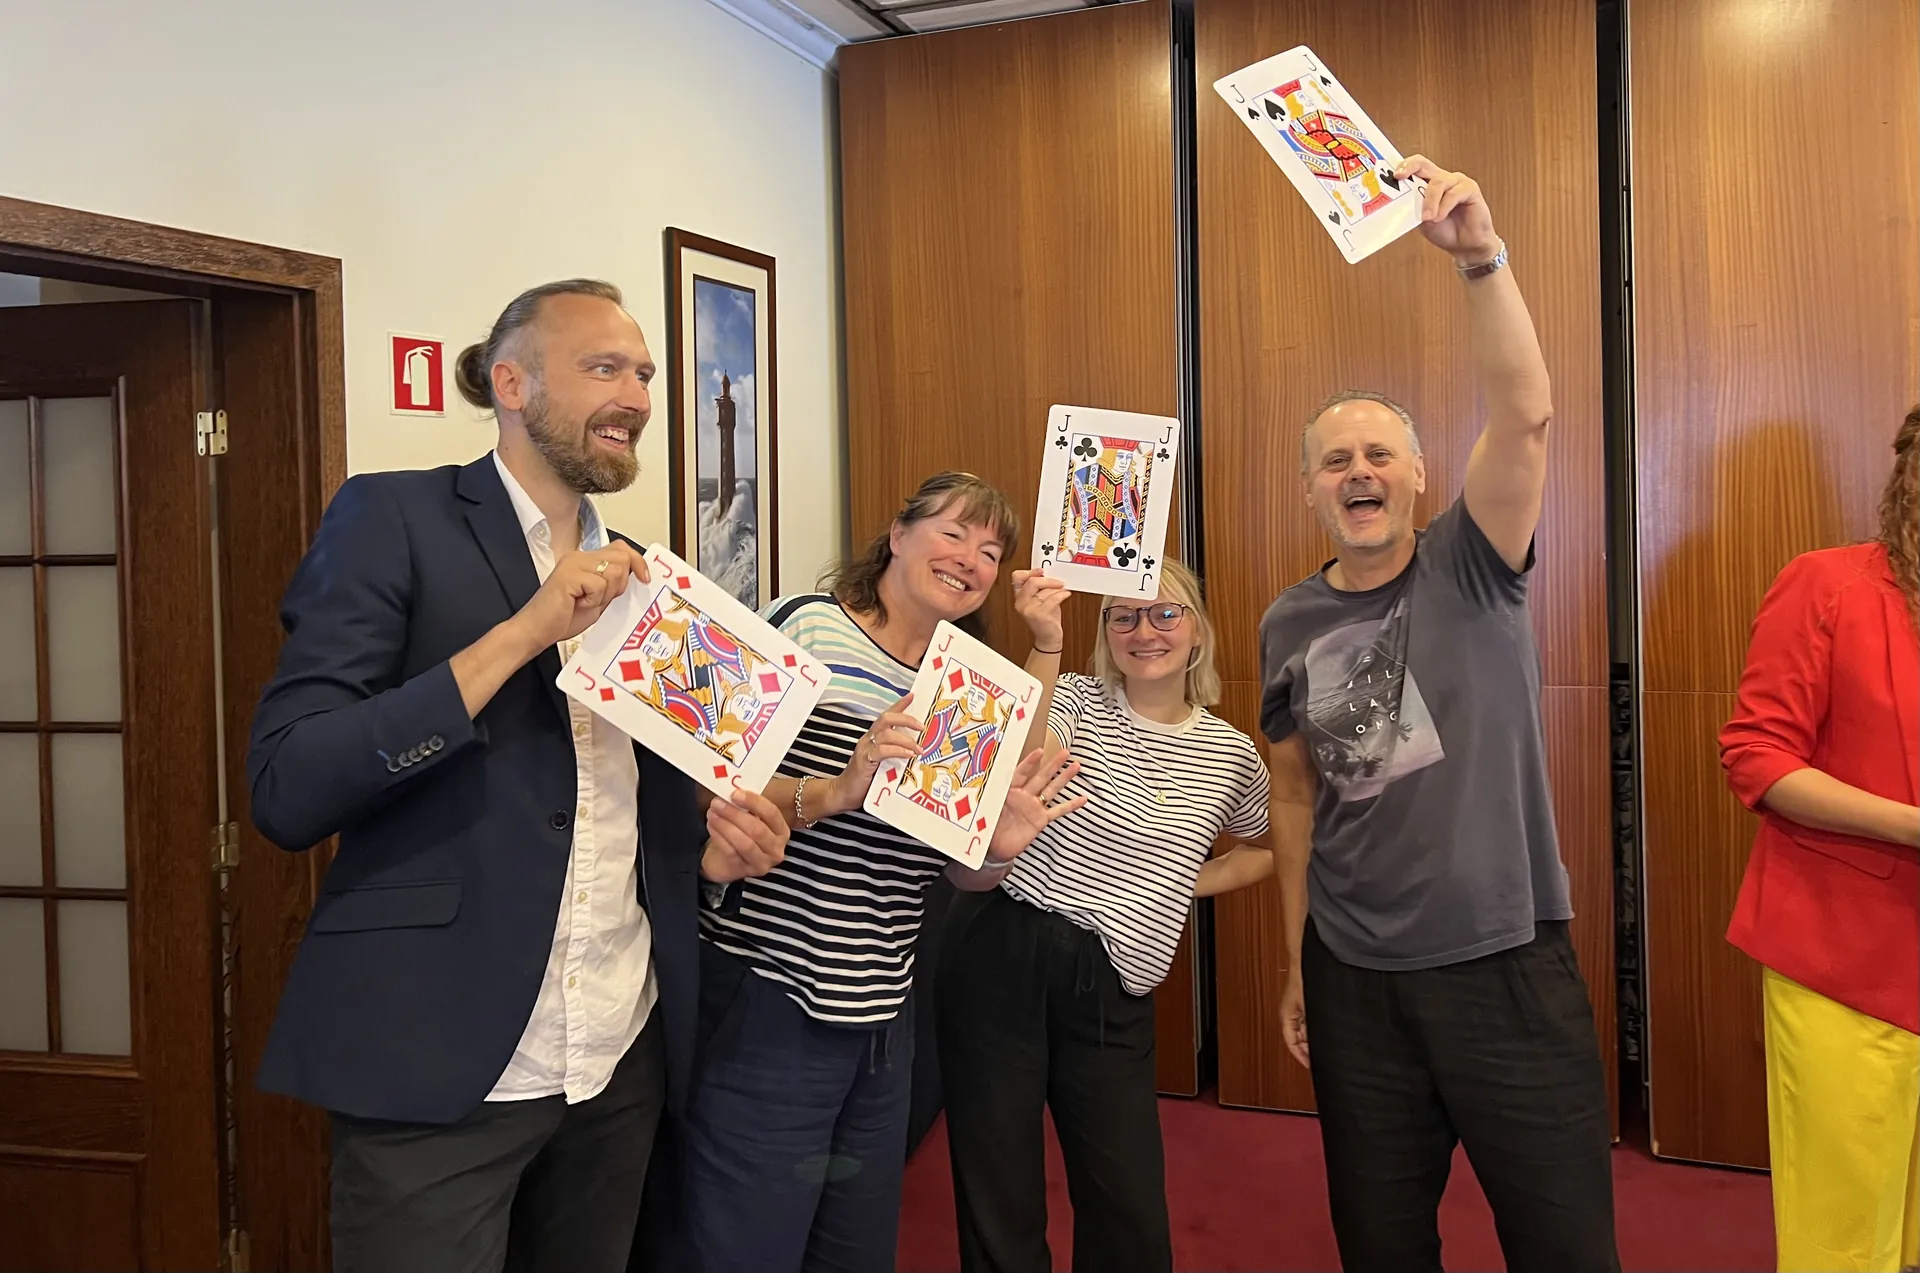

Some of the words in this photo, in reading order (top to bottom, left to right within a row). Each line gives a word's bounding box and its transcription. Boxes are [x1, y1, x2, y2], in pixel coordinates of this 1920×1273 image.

[1302, 54, 1317, 72] J
[1230, 84, 1245, 104] J
[1342, 229, 1356, 252] J
[1057, 415, 1072, 433] J
[1159, 426, 1173, 445] J
[653, 554, 673, 579] J
[1138, 573, 1153, 592] J
[938, 634, 955, 652] J
[575, 666, 596, 691] J
[800, 664, 818, 688] J
[1020, 686, 1035, 704] J
[1355, 711, 1397, 734] ONG
[872, 787, 891, 807] J
[964, 836, 981, 856] J
